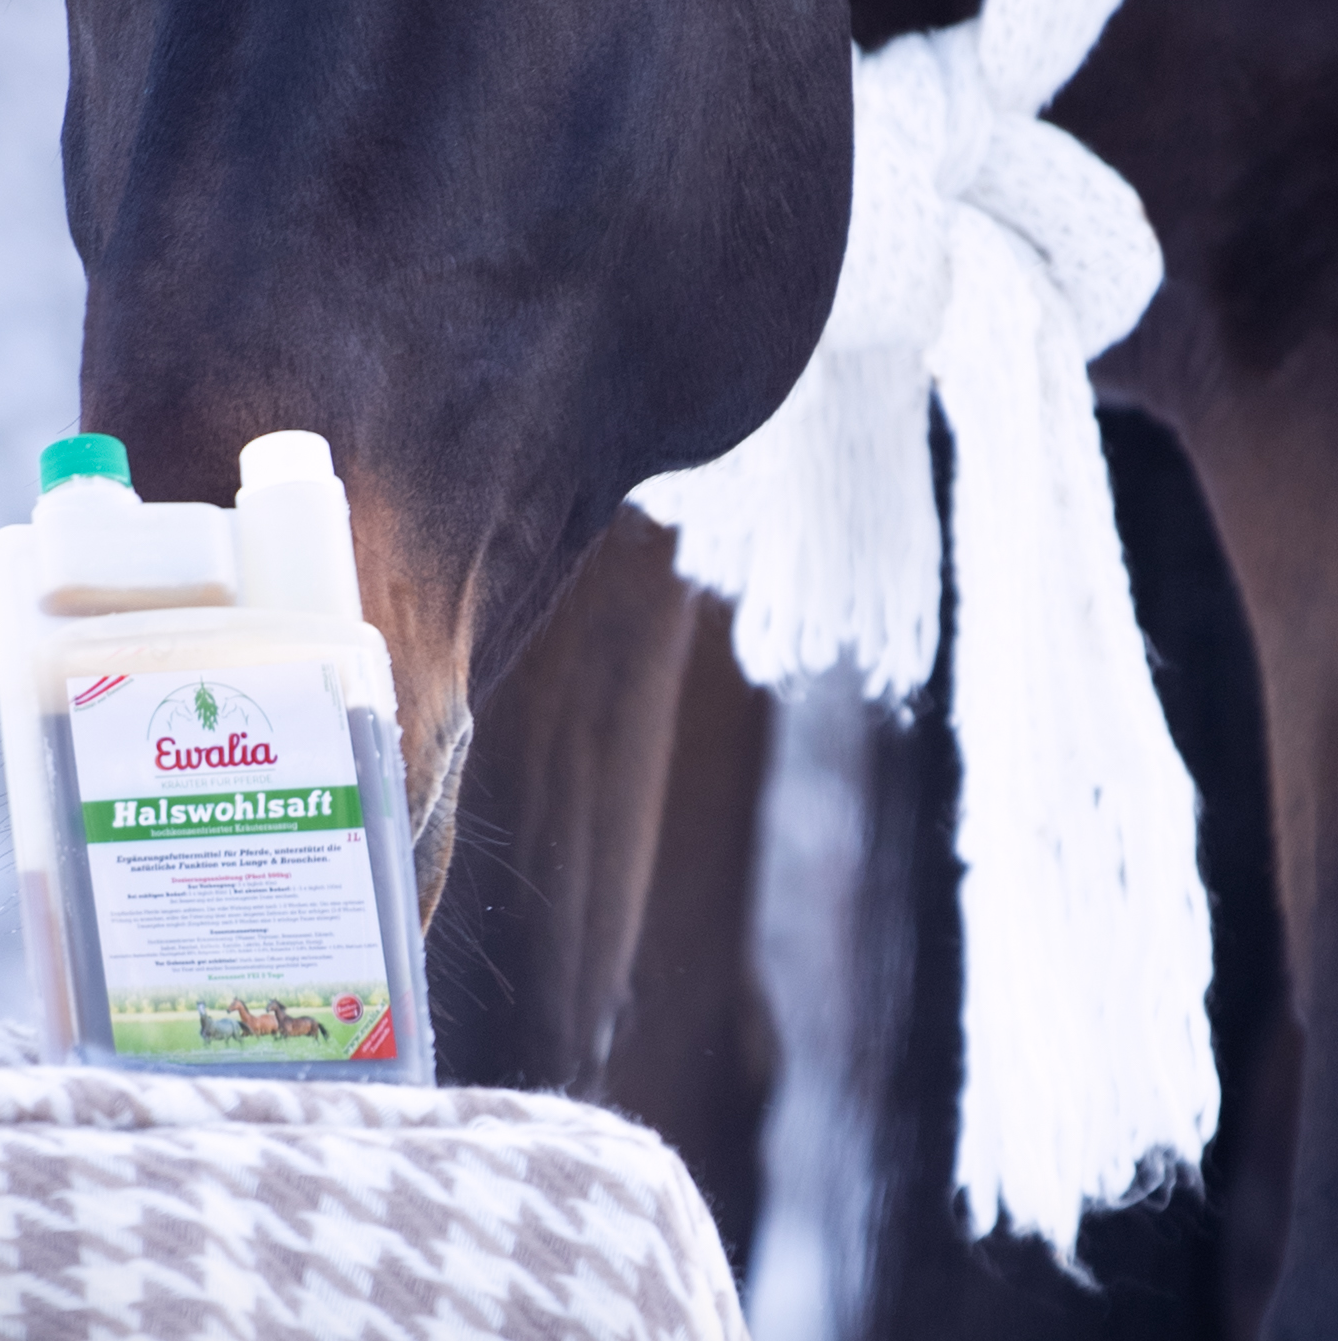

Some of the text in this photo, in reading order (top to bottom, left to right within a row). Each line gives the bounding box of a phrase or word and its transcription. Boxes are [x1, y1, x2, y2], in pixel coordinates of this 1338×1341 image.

[155, 732, 278, 771] Ewalia
[161, 777, 207, 789] KRÄUTER
[234, 773, 273, 785] PFERDE
[112, 789, 333, 828] Halswohlsaft
[116, 850, 221, 864] Ergänzungsfuttermittel
[240, 847, 272, 857] Pferde,
[274, 845, 325, 855] unterstützt
[327, 844, 342, 852] die
[130, 863, 176, 872] natürliche
[178, 861, 218, 870] Funktion
[240, 859, 268, 868] Lunge
[270, 857, 277, 865] &
[280, 856, 330, 865] Bronchien.
